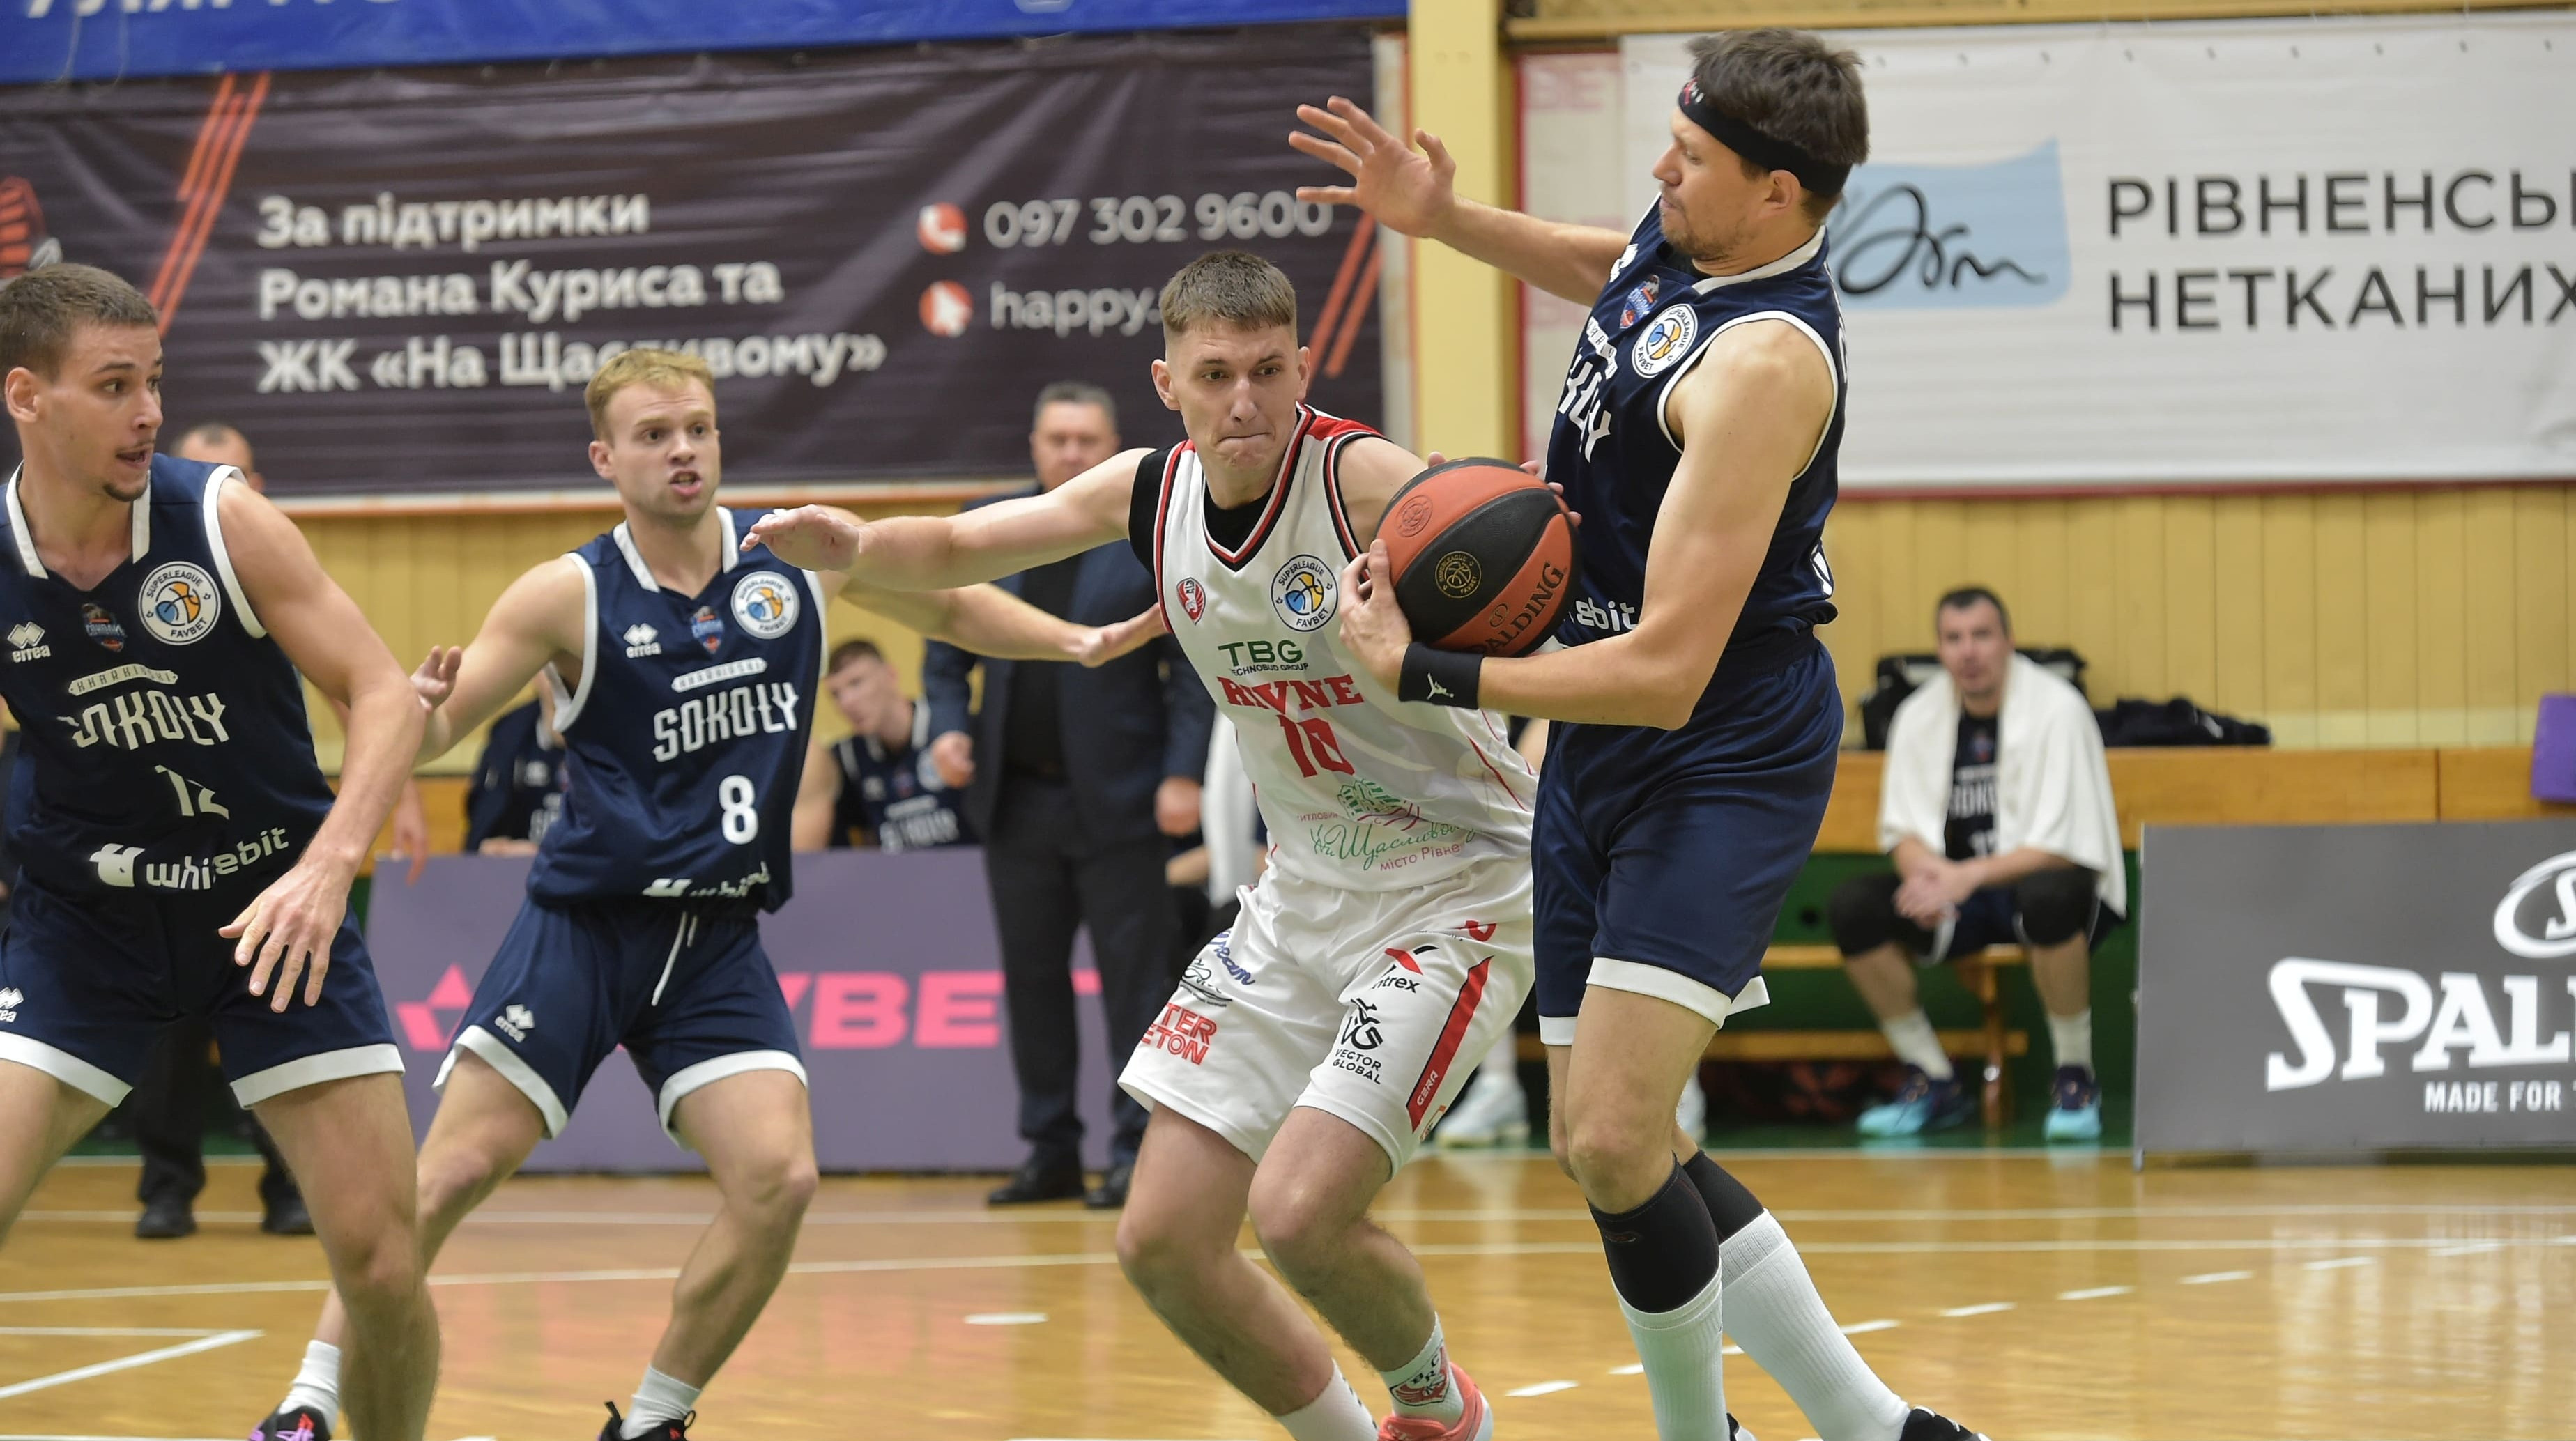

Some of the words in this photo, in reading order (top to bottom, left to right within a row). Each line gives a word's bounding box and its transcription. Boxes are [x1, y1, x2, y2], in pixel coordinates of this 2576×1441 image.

[984, 199, 1080, 249] 097
[1089, 195, 1188, 244] 302
[1194, 190, 1334, 241] 9600
[2108, 169, 2576, 237] РІВНЕНСЬ
[257, 194, 330, 249] За
[343, 191, 650, 253] підтримки
[260, 268, 479, 321] Романа
[491, 259, 707, 323] Куриса
[712, 261, 785, 305] та
[257, 338, 361, 393] ЖК
[371, 334, 487, 389] «На
[146, 570, 203, 599] SUPERLEAGUE
[1278, 560, 1325, 586] SUPERLEAGUE
[170, 617, 207, 638] FAVBET
[1296, 607, 1329, 627] FAVBET
[12, 645, 51, 663] errea
[626, 642, 662, 658] errea
[1218, 640, 1303, 667] TBG
[1229, 664, 1279, 677] ECHNOBUD
[1280, 663, 1309, 671] GROUP
[1216, 673, 1365, 715] RIVNE
[652, 681, 799, 762] SOKOLY
[1275, 714, 1355, 778] 10
[718, 774, 758, 845] 8
[145, 826, 290, 891] whiebit
[494, 1015, 526, 1043] errea
[2265, 957, 2576, 1093] SPAL
[1332, 1058, 1381, 1085] GLOBAL
[1335, 1048, 1382, 1071] VECTOR
[2424, 1081, 2499, 1114] MADE
[2509, 1081, 2562, 1113] FOR
